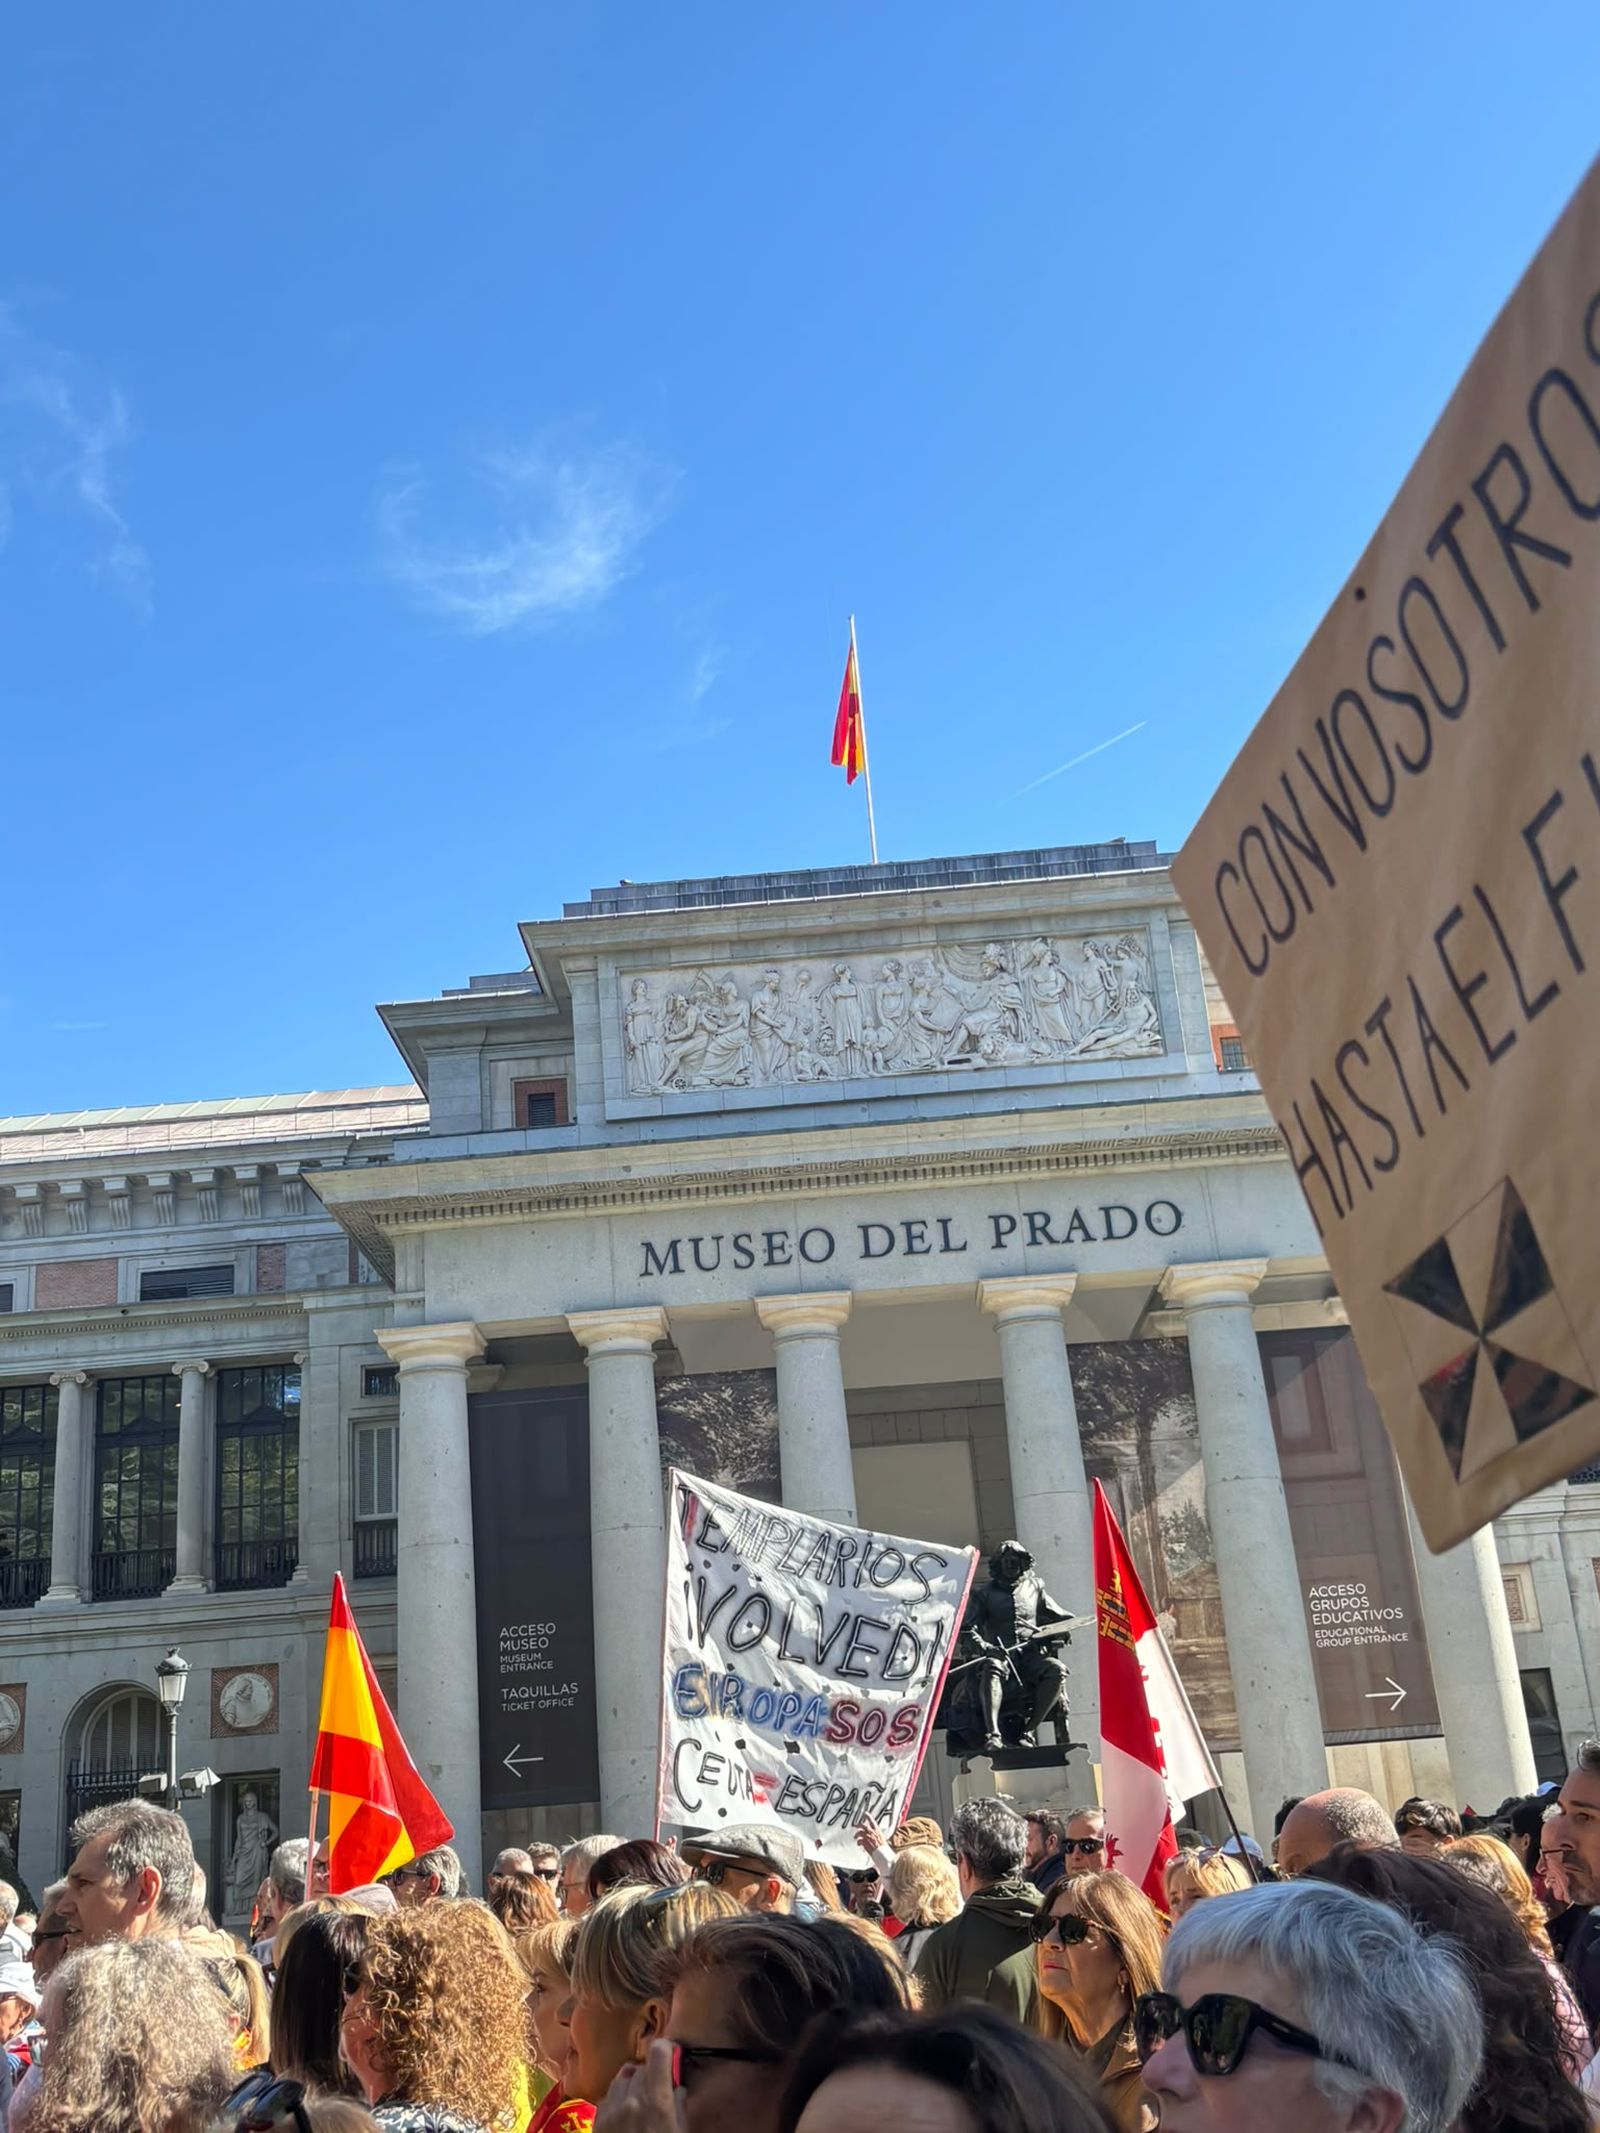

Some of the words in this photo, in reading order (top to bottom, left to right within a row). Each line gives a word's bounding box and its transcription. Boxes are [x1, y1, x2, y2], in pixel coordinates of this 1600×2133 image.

[1296, 287, 1600, 854] VOSOTRO
[639, 1226, 837, 1278] MUSEO
[857, 1216, 968, 1260] DEL
[987, 1199, 1183, 1250] PRADO
[677, 1484, 948, 1607] TEMPLARIOS
[1309, 1583, 1367, 1598] ACCESO
[1310, 1596, 1370, 1611] GRUPOS
[1312, 1607, 1404, 1625] EDUCATIVOS
[500, 1622, 557, 1637] ACCESO
[1314, 1625, 1387, 1639] EDUCATIONAL
[500, 1637, 550, 1652] MUSEO
[1316, 1637, 1352, 1648] GROUP
[1354, 1633, 1409, 1645] ENTRANCE
[500, 1652, 542, 1664] MUSEUM
[500, 1661, 554, 1673] ENTRANCE
[501, 1682, 579, 1700] TAQUILLAS
[501, 1701, 536, 1712] TICKET
[538, 1698, 575, 1709] OFFICE
[825, 1699, 920, 1747] SOS
[774, 1774, 899, 1829] ESPAÑA
